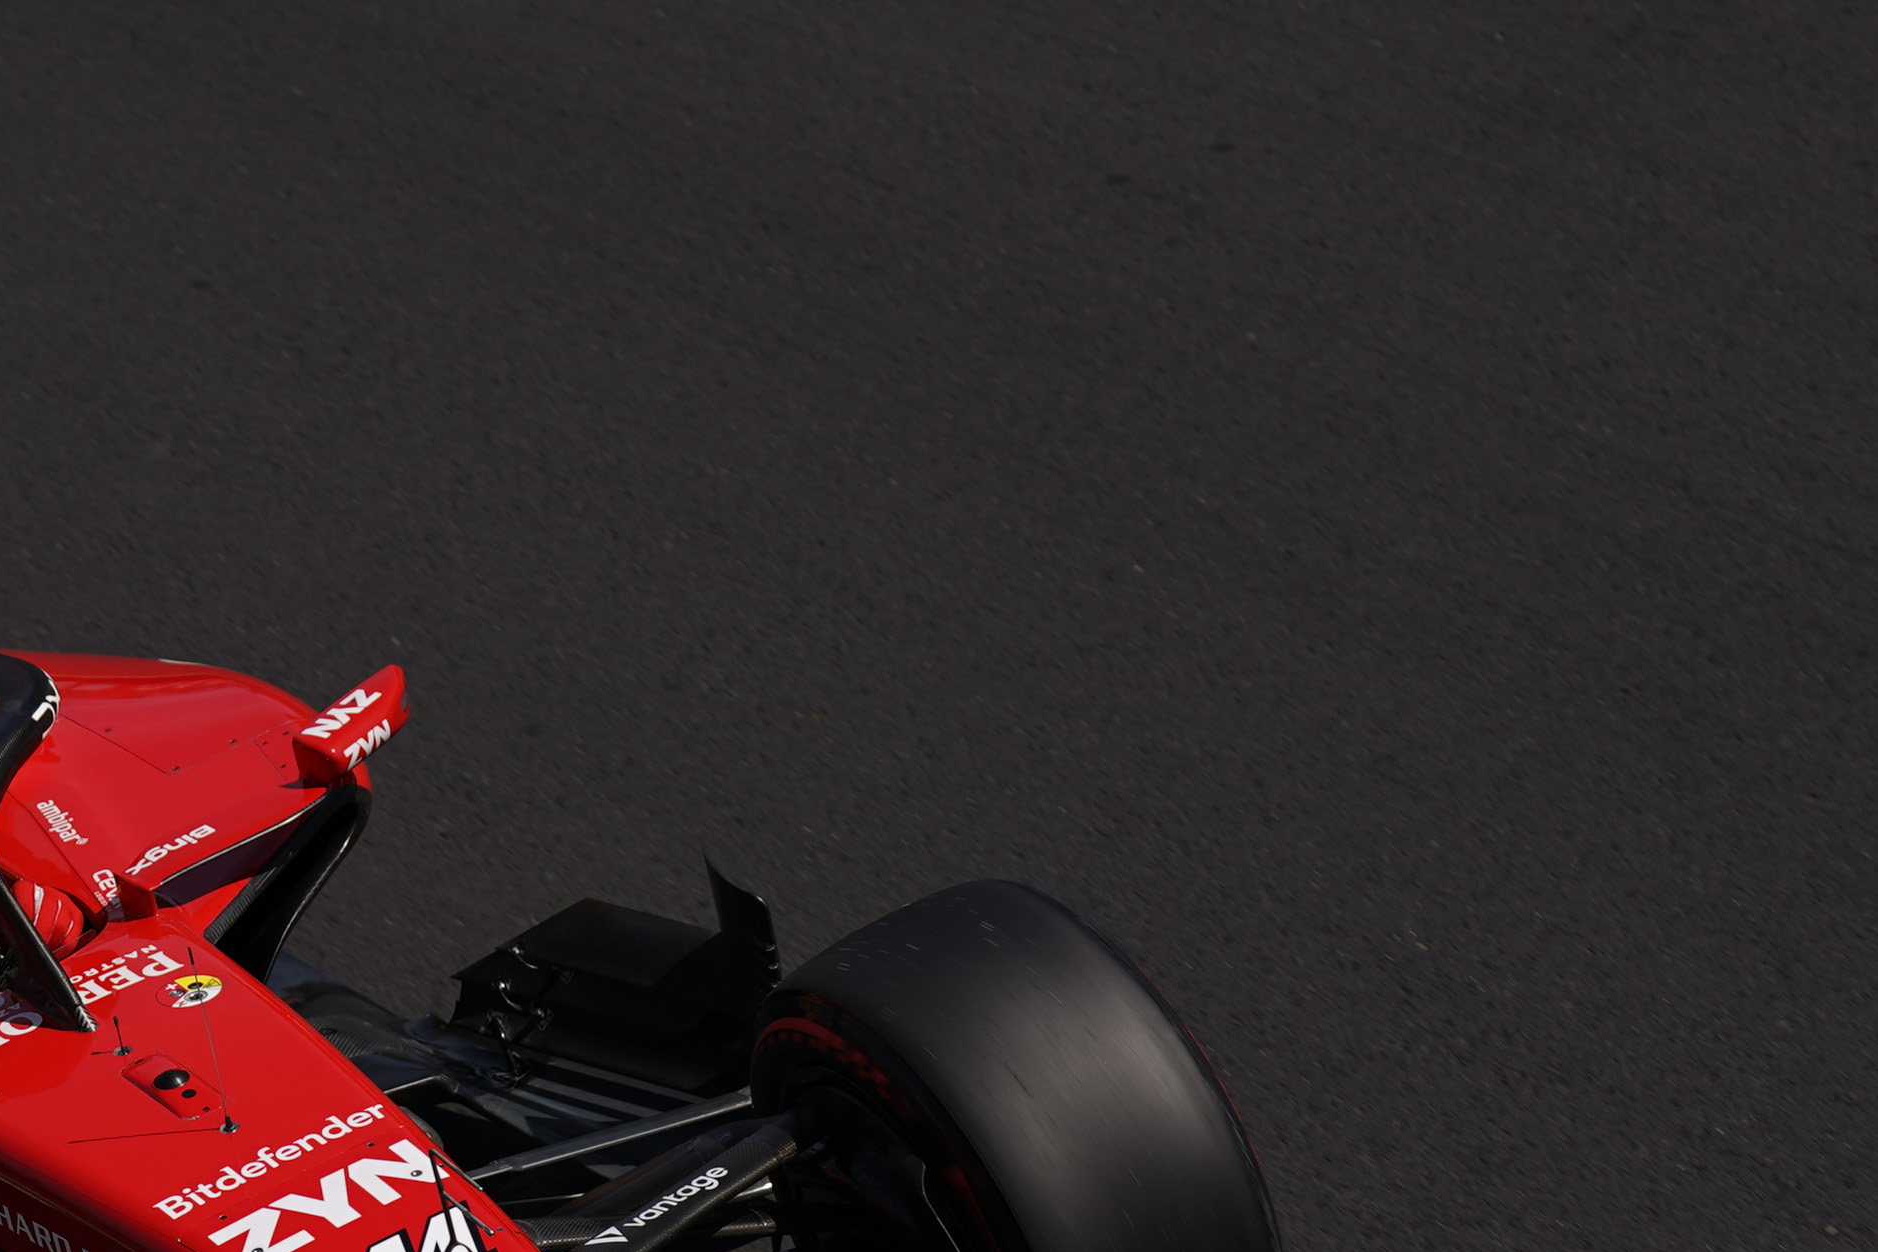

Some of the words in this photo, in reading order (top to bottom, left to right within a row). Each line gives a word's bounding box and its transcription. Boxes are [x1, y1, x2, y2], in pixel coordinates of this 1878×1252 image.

[301, 687, 382, 739] ZYN
[343, 719, 391, 772] ZYN
[153, 1104, 385, 1220] Bitdefender
[624, 1165, 729, 1228] vantage
